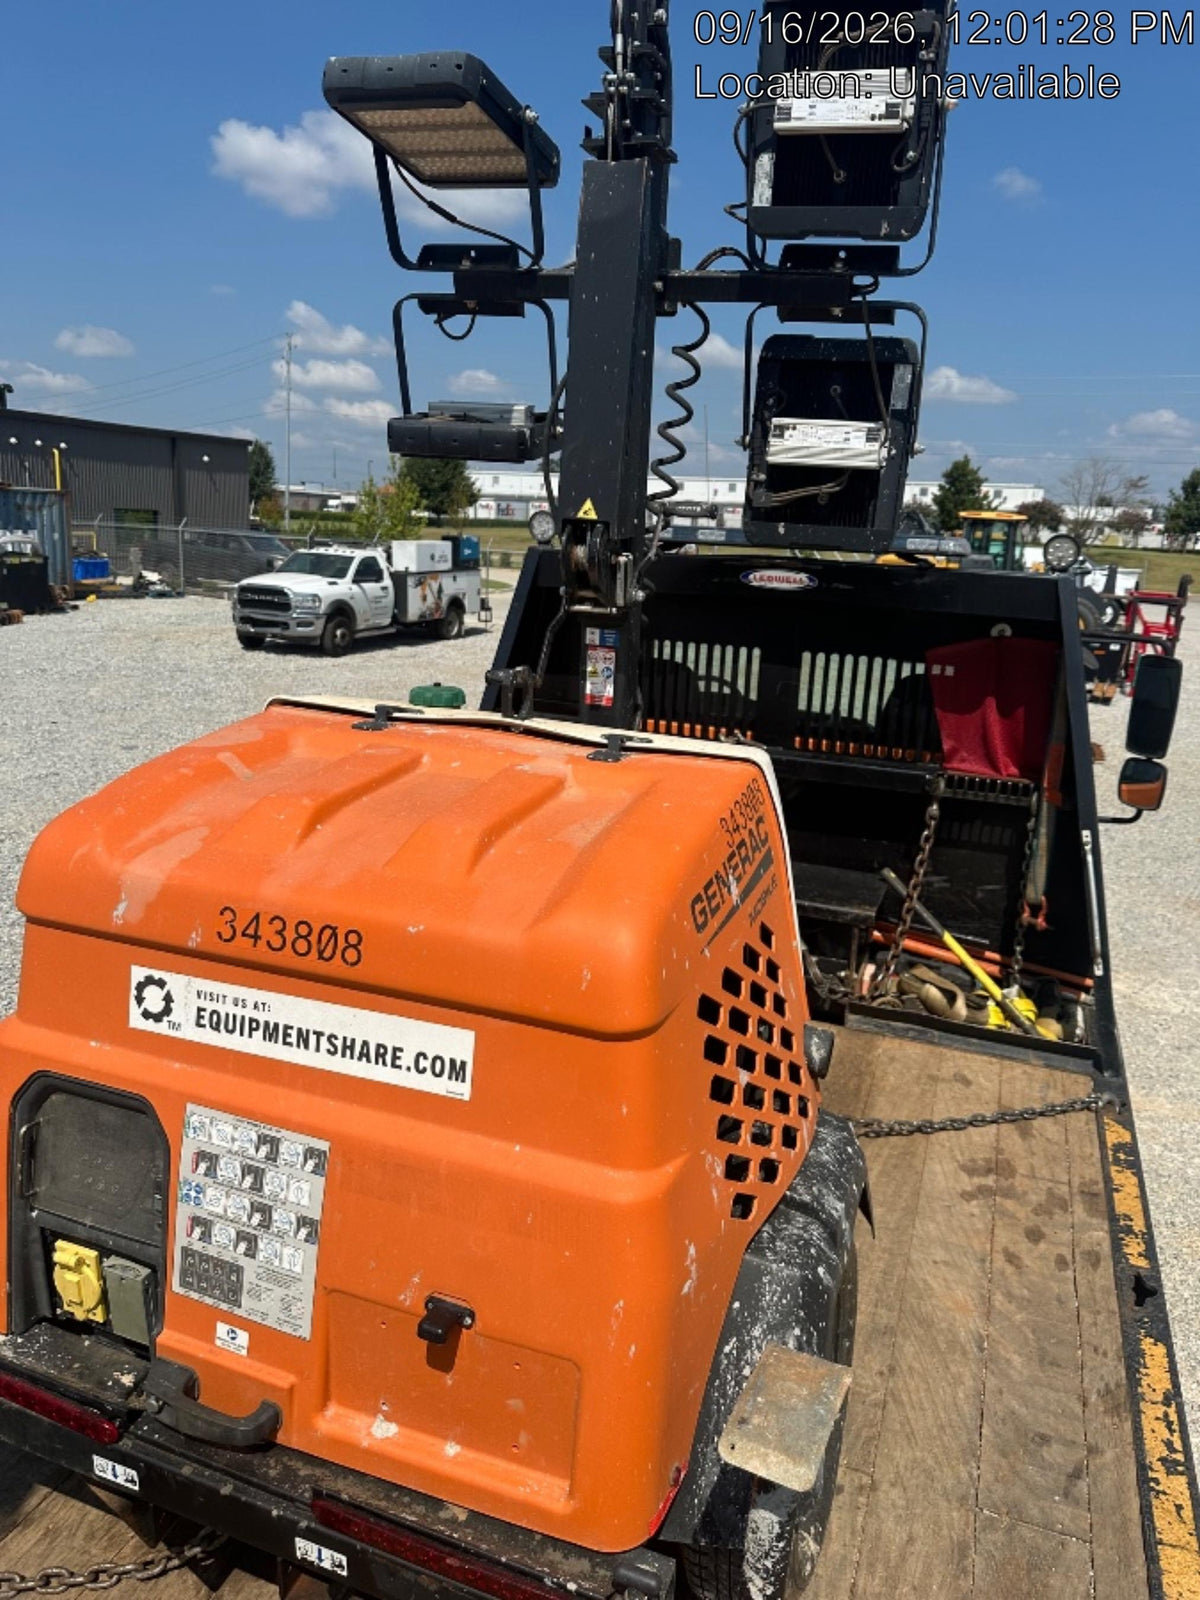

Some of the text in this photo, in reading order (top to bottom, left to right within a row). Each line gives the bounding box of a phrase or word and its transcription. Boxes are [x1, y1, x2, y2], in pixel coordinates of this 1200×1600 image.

[690, 814, 769, 934] GENERAC
[216, 906, 362, 967] 343808
[196, 990, 272, 1013] VISIT US AT:
[195, 1006, 468, 1084] EQUIPMENTSHARE.COM
